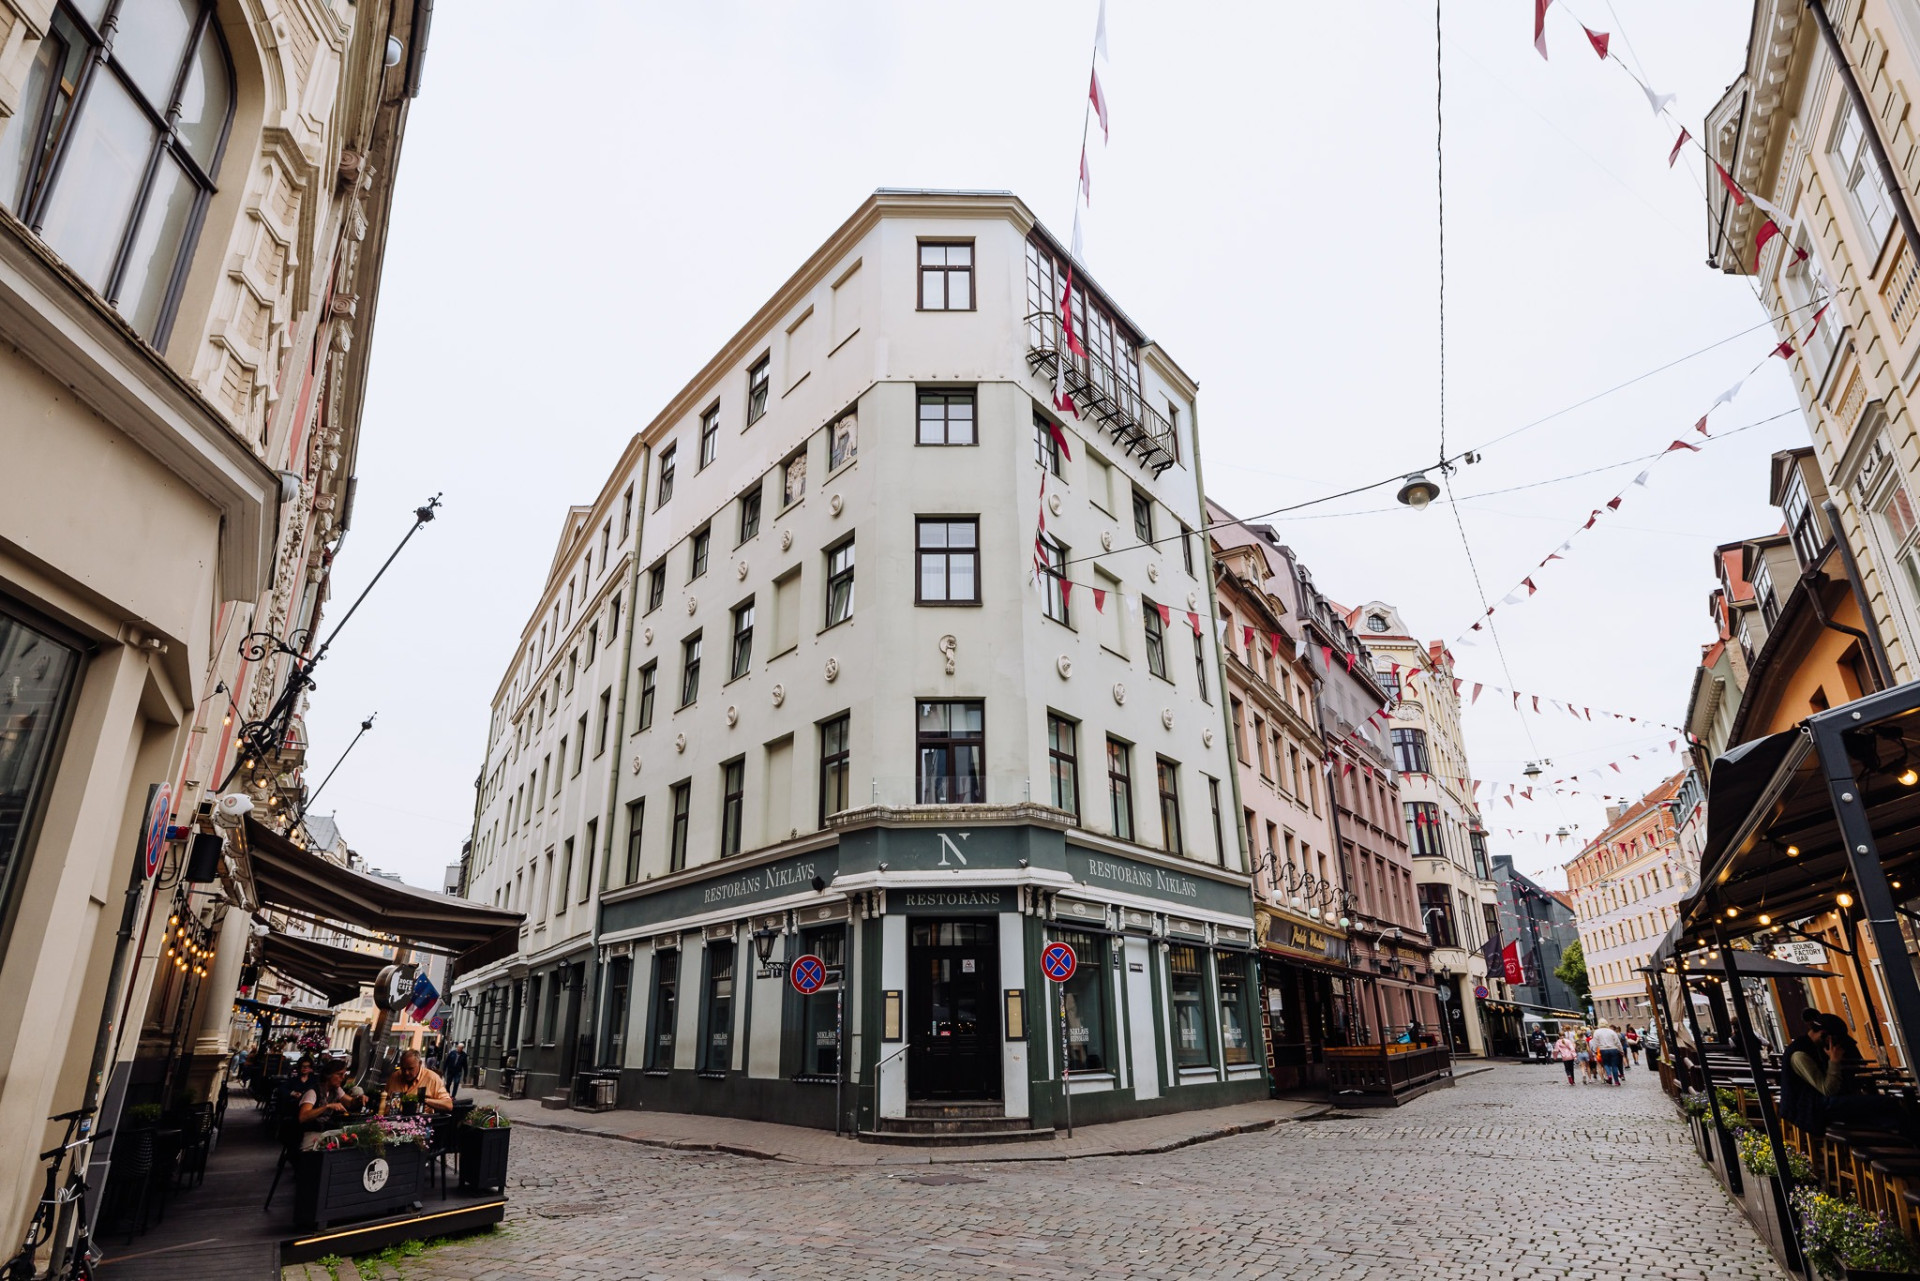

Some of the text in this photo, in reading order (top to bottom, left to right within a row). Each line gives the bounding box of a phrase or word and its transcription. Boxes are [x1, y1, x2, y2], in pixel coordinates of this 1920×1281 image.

[937, 833, 970, 866] N
[1089, 859, 1152, 888] RESTORĀNS
[704, 877, 760, 903] RESTORĀNS
[905, 890, 1000, 906] RESTORĀNS
